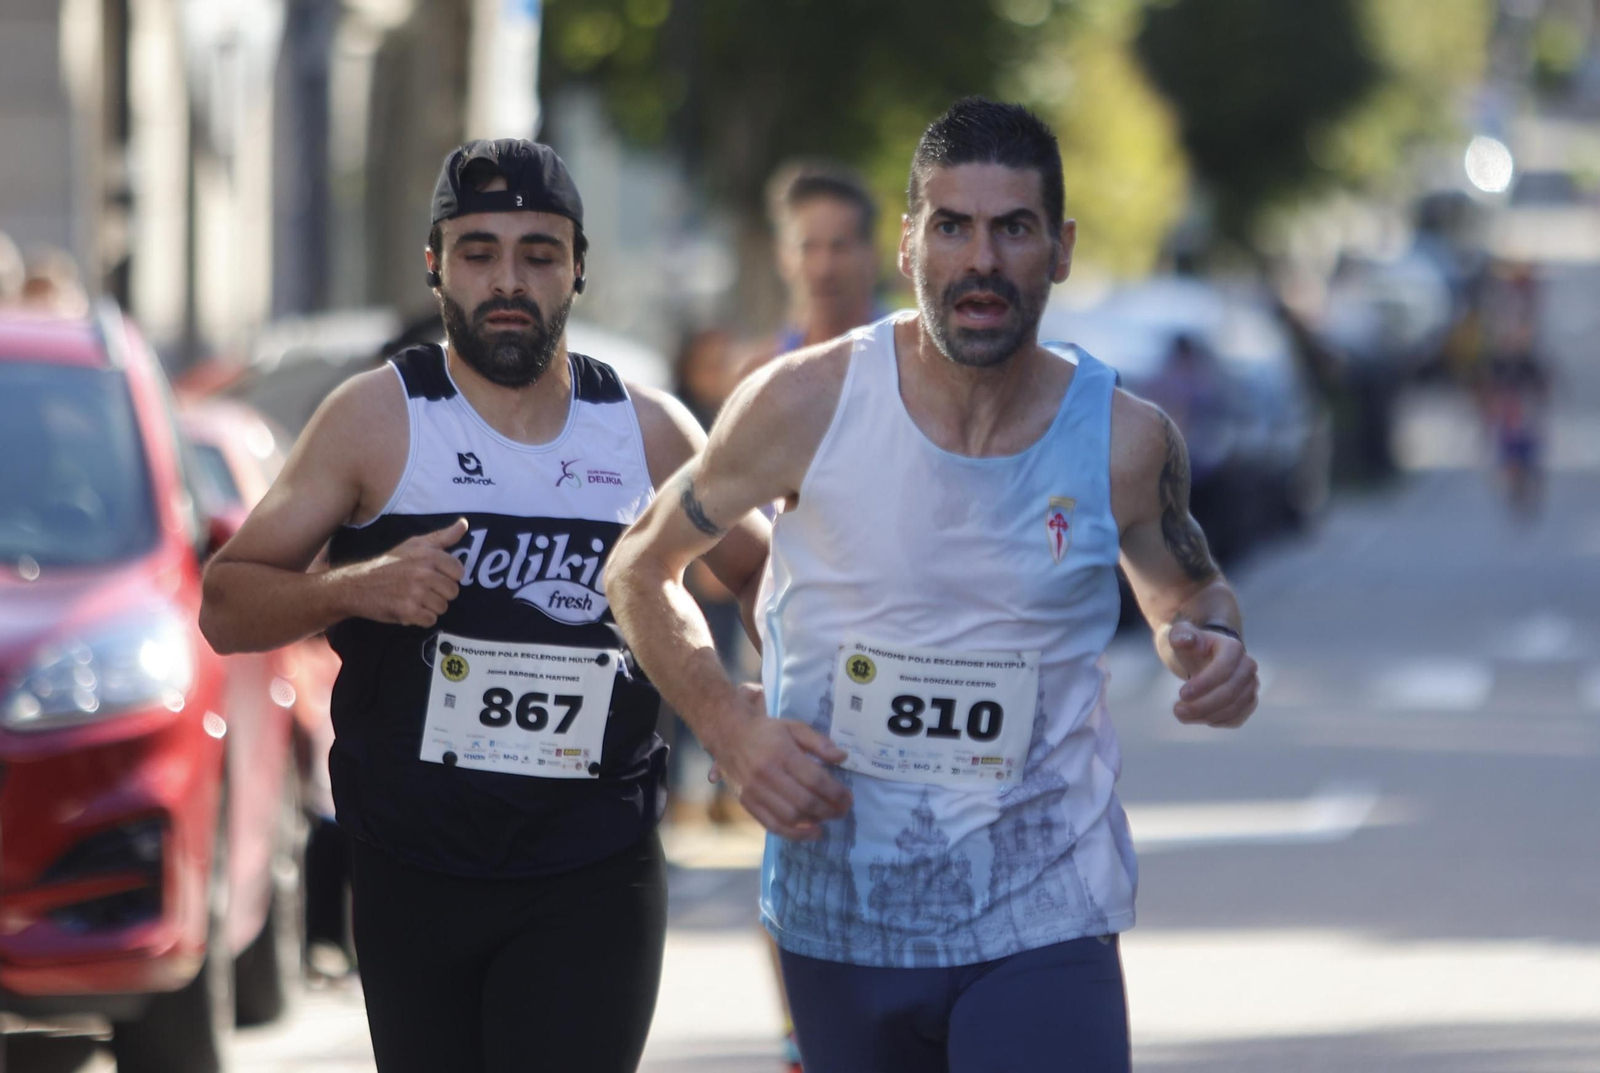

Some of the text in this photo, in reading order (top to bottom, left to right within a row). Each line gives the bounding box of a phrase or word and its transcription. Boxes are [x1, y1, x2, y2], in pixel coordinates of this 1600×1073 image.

[587, 475, 623, 486] DELIKIA
[548, 590, 593, 612] fresh
[497, 650, 520, 659] POLA
[520, 652, 567, 663] ESCLEROSE
[907, 656, 931, 665] POLA
[933, 658, 985, 668] ESCLEROSE
[545, 674, 580, 683] MARTINEZ
[965, 680, 997, 689] CASTRO
[479, 687, 584, 735] 867
[887, 694, 1004, 744] 810
